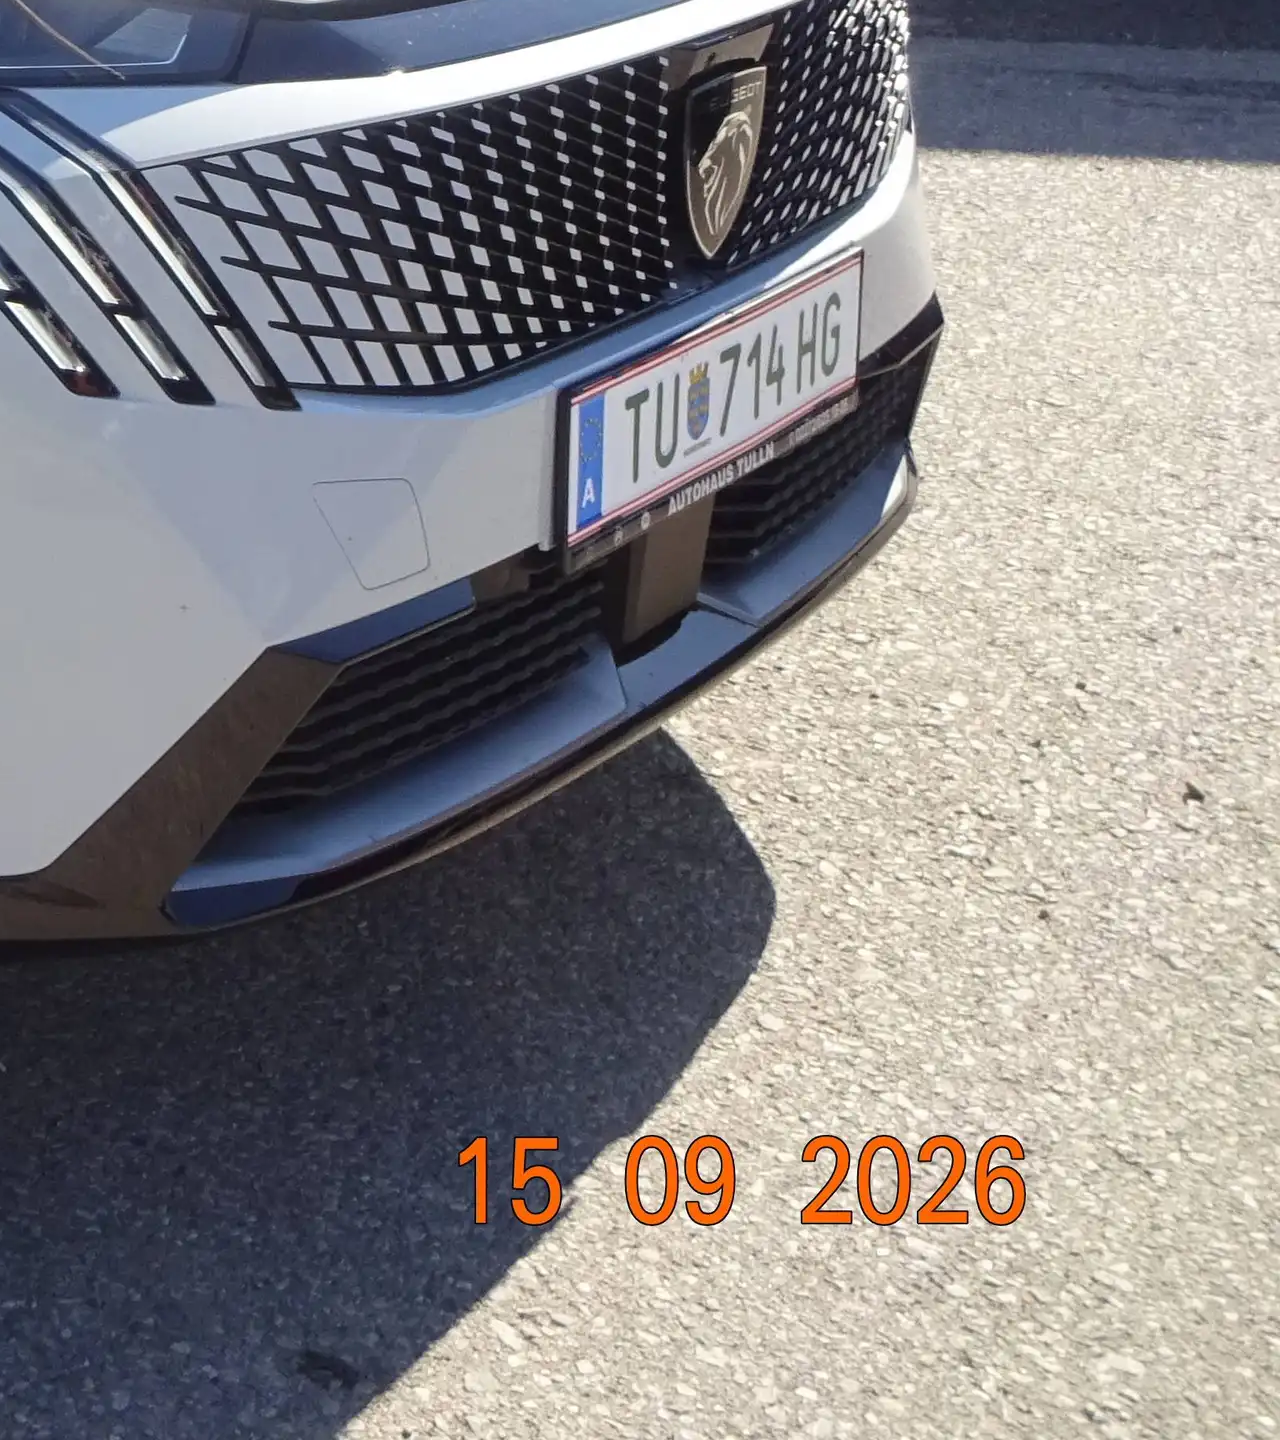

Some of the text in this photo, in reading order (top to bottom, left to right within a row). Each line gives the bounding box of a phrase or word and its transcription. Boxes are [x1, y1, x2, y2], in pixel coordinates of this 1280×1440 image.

[706, 81, 762, 112] EUGEOT
[624, 373, 680, 484] TU
[719, 324, 786, 438] 714
[796, 292, 842, 394] HG
[582, 477, 596, 508] A
[668, 466, 735, 517] AUTOHAUS
[735, 440, 775, 480] TULLN
